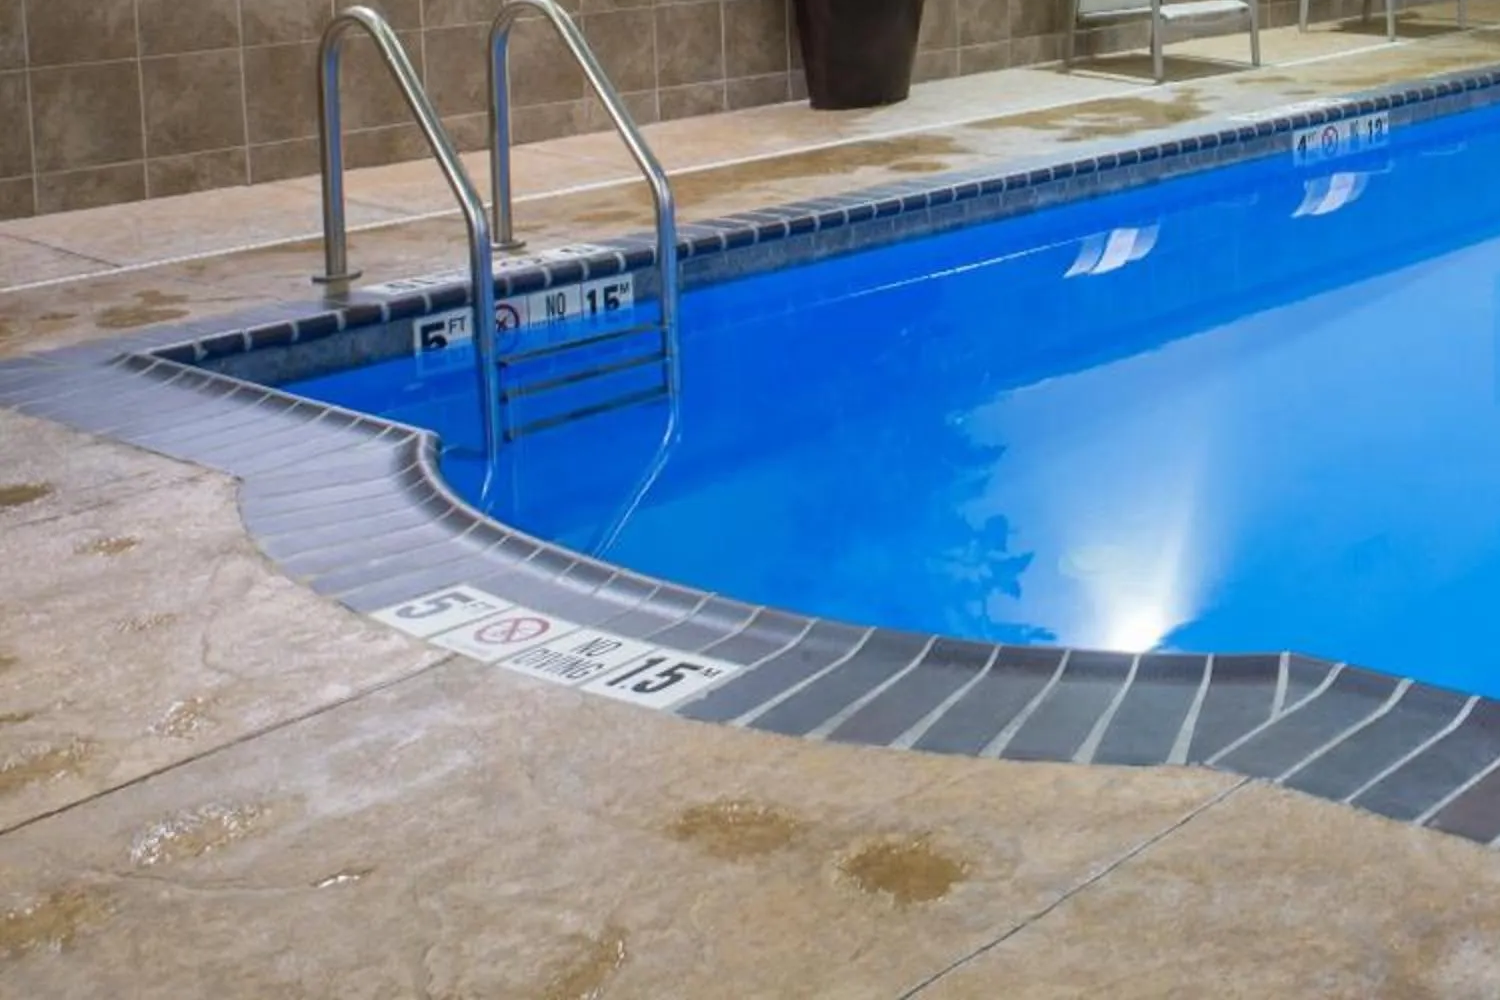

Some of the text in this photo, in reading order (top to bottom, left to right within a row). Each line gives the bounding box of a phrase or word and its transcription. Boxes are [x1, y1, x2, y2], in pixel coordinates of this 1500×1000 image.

[420, 320, 448, 350] 5
[450, 315, 468, 335] FT
[546, 292, 566, 320] NO
[395, 591, 475, 619] 5
